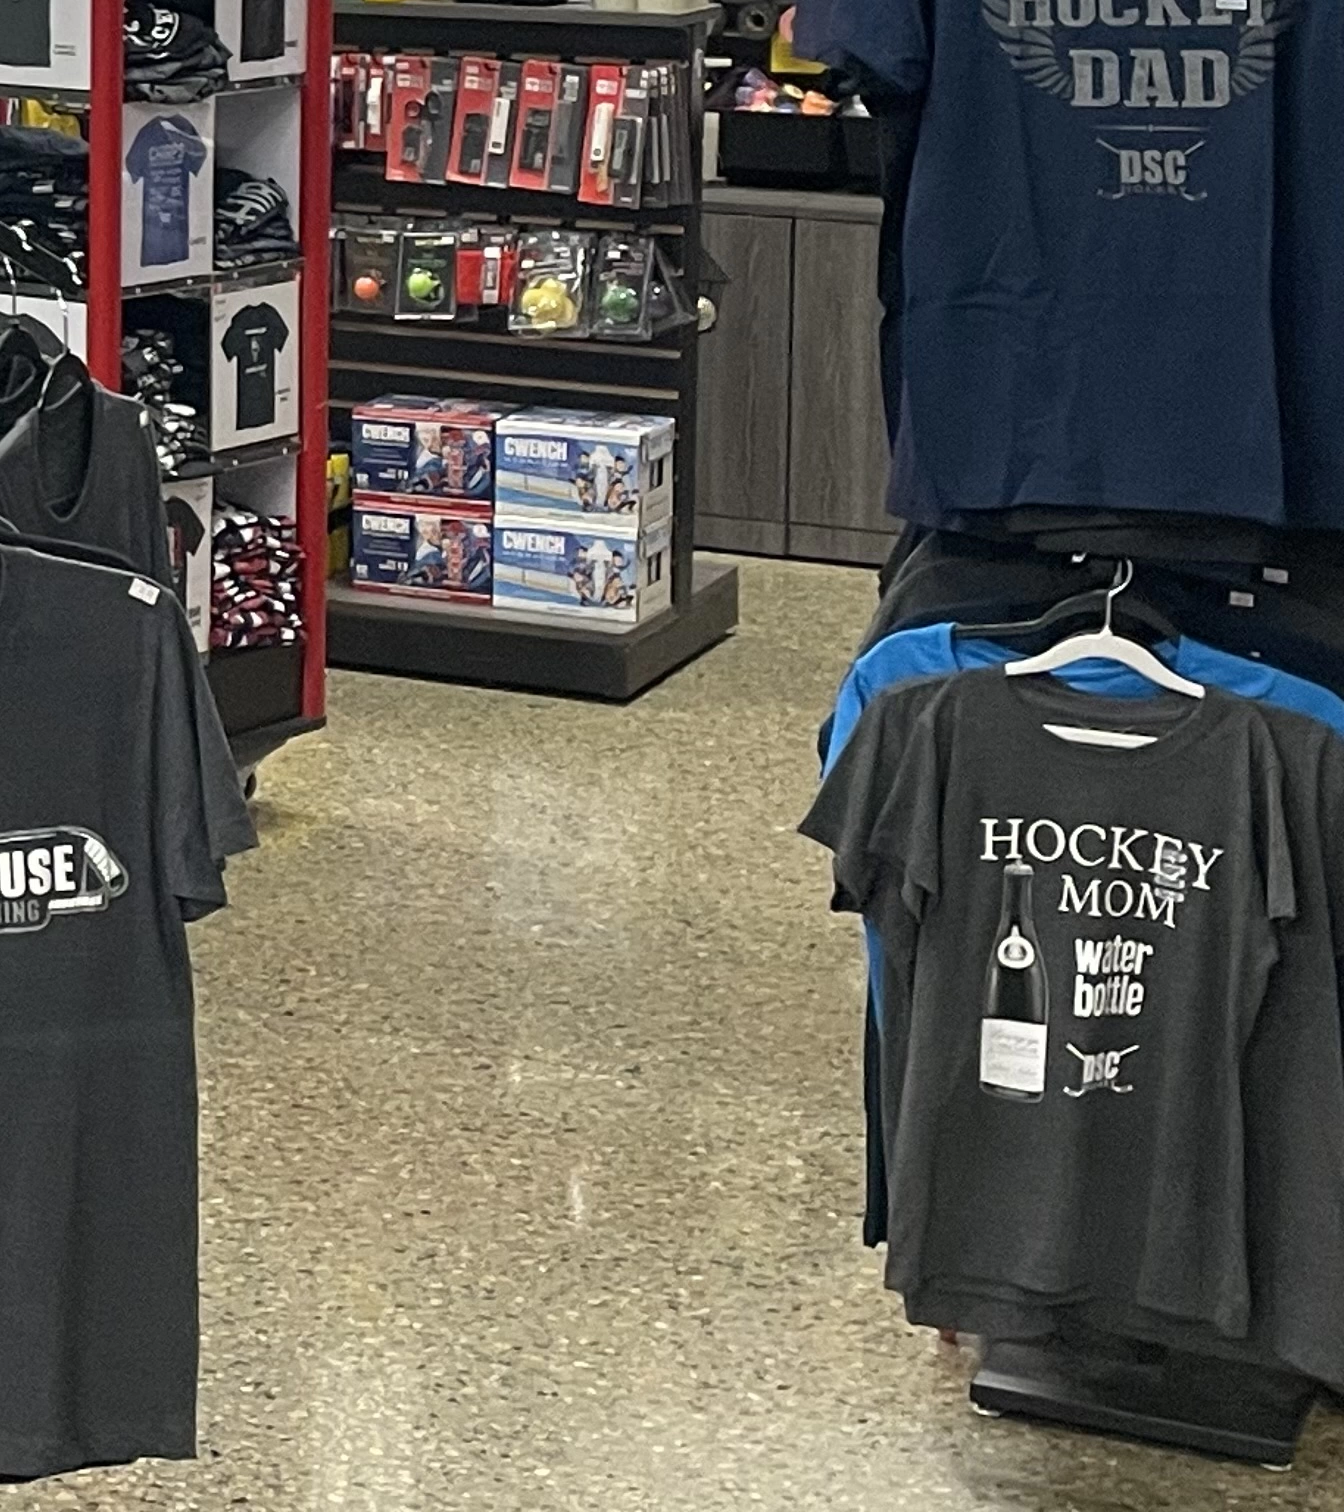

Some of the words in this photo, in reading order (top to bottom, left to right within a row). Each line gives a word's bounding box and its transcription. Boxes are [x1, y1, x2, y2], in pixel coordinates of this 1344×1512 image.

[1068, 47, 1232, 109] DAD
[1119, 149, 1187, 185] DSC
[503, 437, 568, 462] CWENCH
[979, 818, 1225, 892] HOCKEY
[1057, 873, 1182, 929] MOM
[1073, 934, 1154, 976] water
[1072, 974, 1145, 1018] bottle
